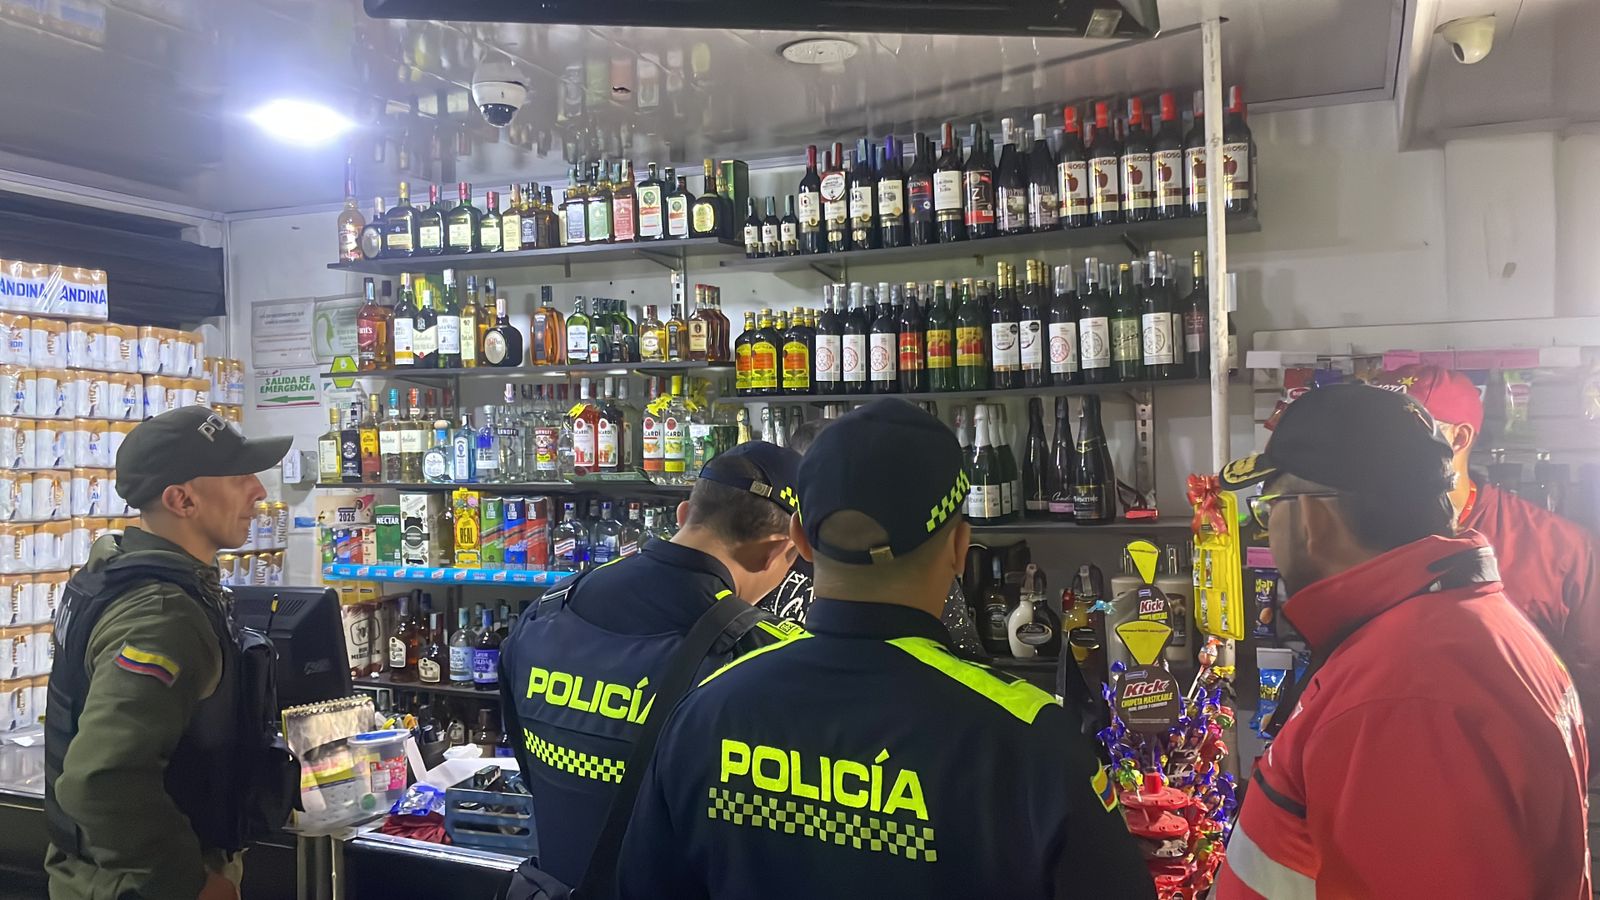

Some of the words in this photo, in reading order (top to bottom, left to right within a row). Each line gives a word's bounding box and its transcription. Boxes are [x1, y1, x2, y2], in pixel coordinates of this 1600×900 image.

[60, 284, 107, 304] ANDINA
[265, 377, 297, 385] SALIDA
[260, 383, 316, 393] EMERGENCIA
[339, 512, 356, 522] 2026
[376, 517, 399, 525] NECTAR
[459, 527, 474, 544] REAL
[1139, 598, 1164, 613] Kick
[1122, 679, 1169, 699] Kick
[1143, 692, 1173, 704] MASTICABLE
[720, 739, 929, 821] POLICÍA
